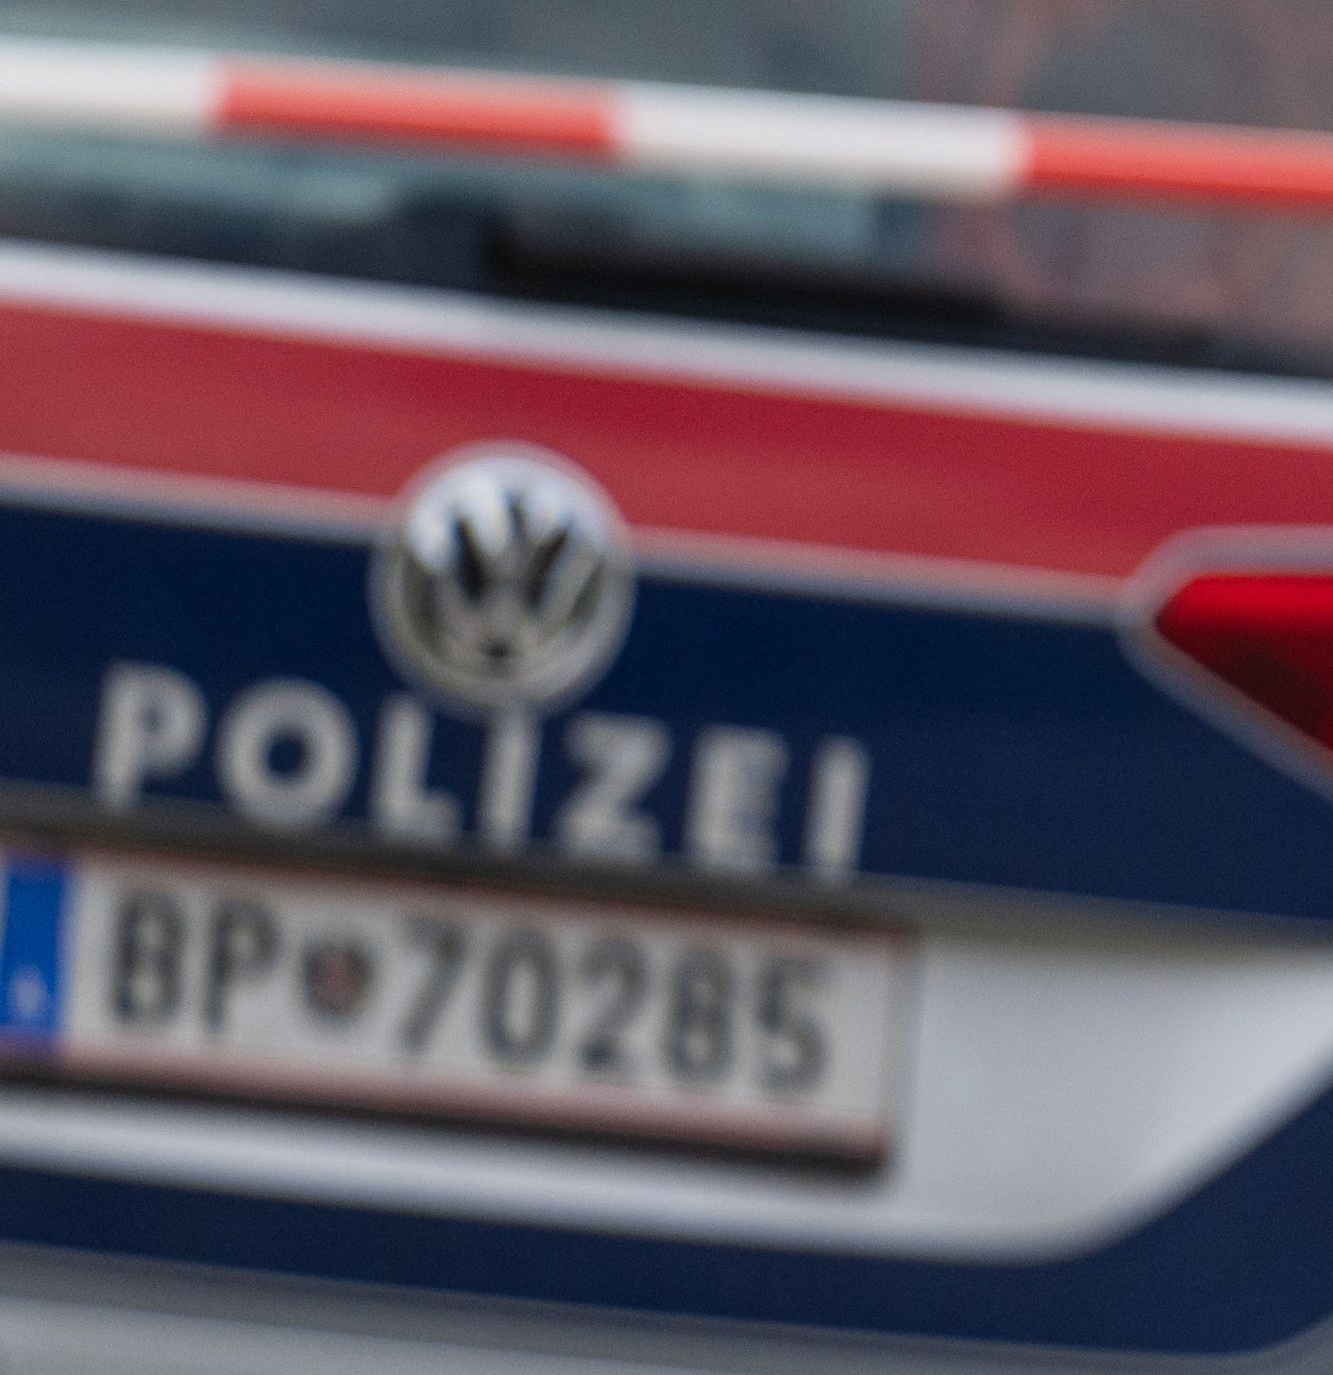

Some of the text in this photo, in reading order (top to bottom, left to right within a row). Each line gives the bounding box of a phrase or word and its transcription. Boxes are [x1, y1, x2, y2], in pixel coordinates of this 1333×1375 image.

[92, 660, 871, 884] POLIZEI
[110, 886, 828, 1098] BP 70285
